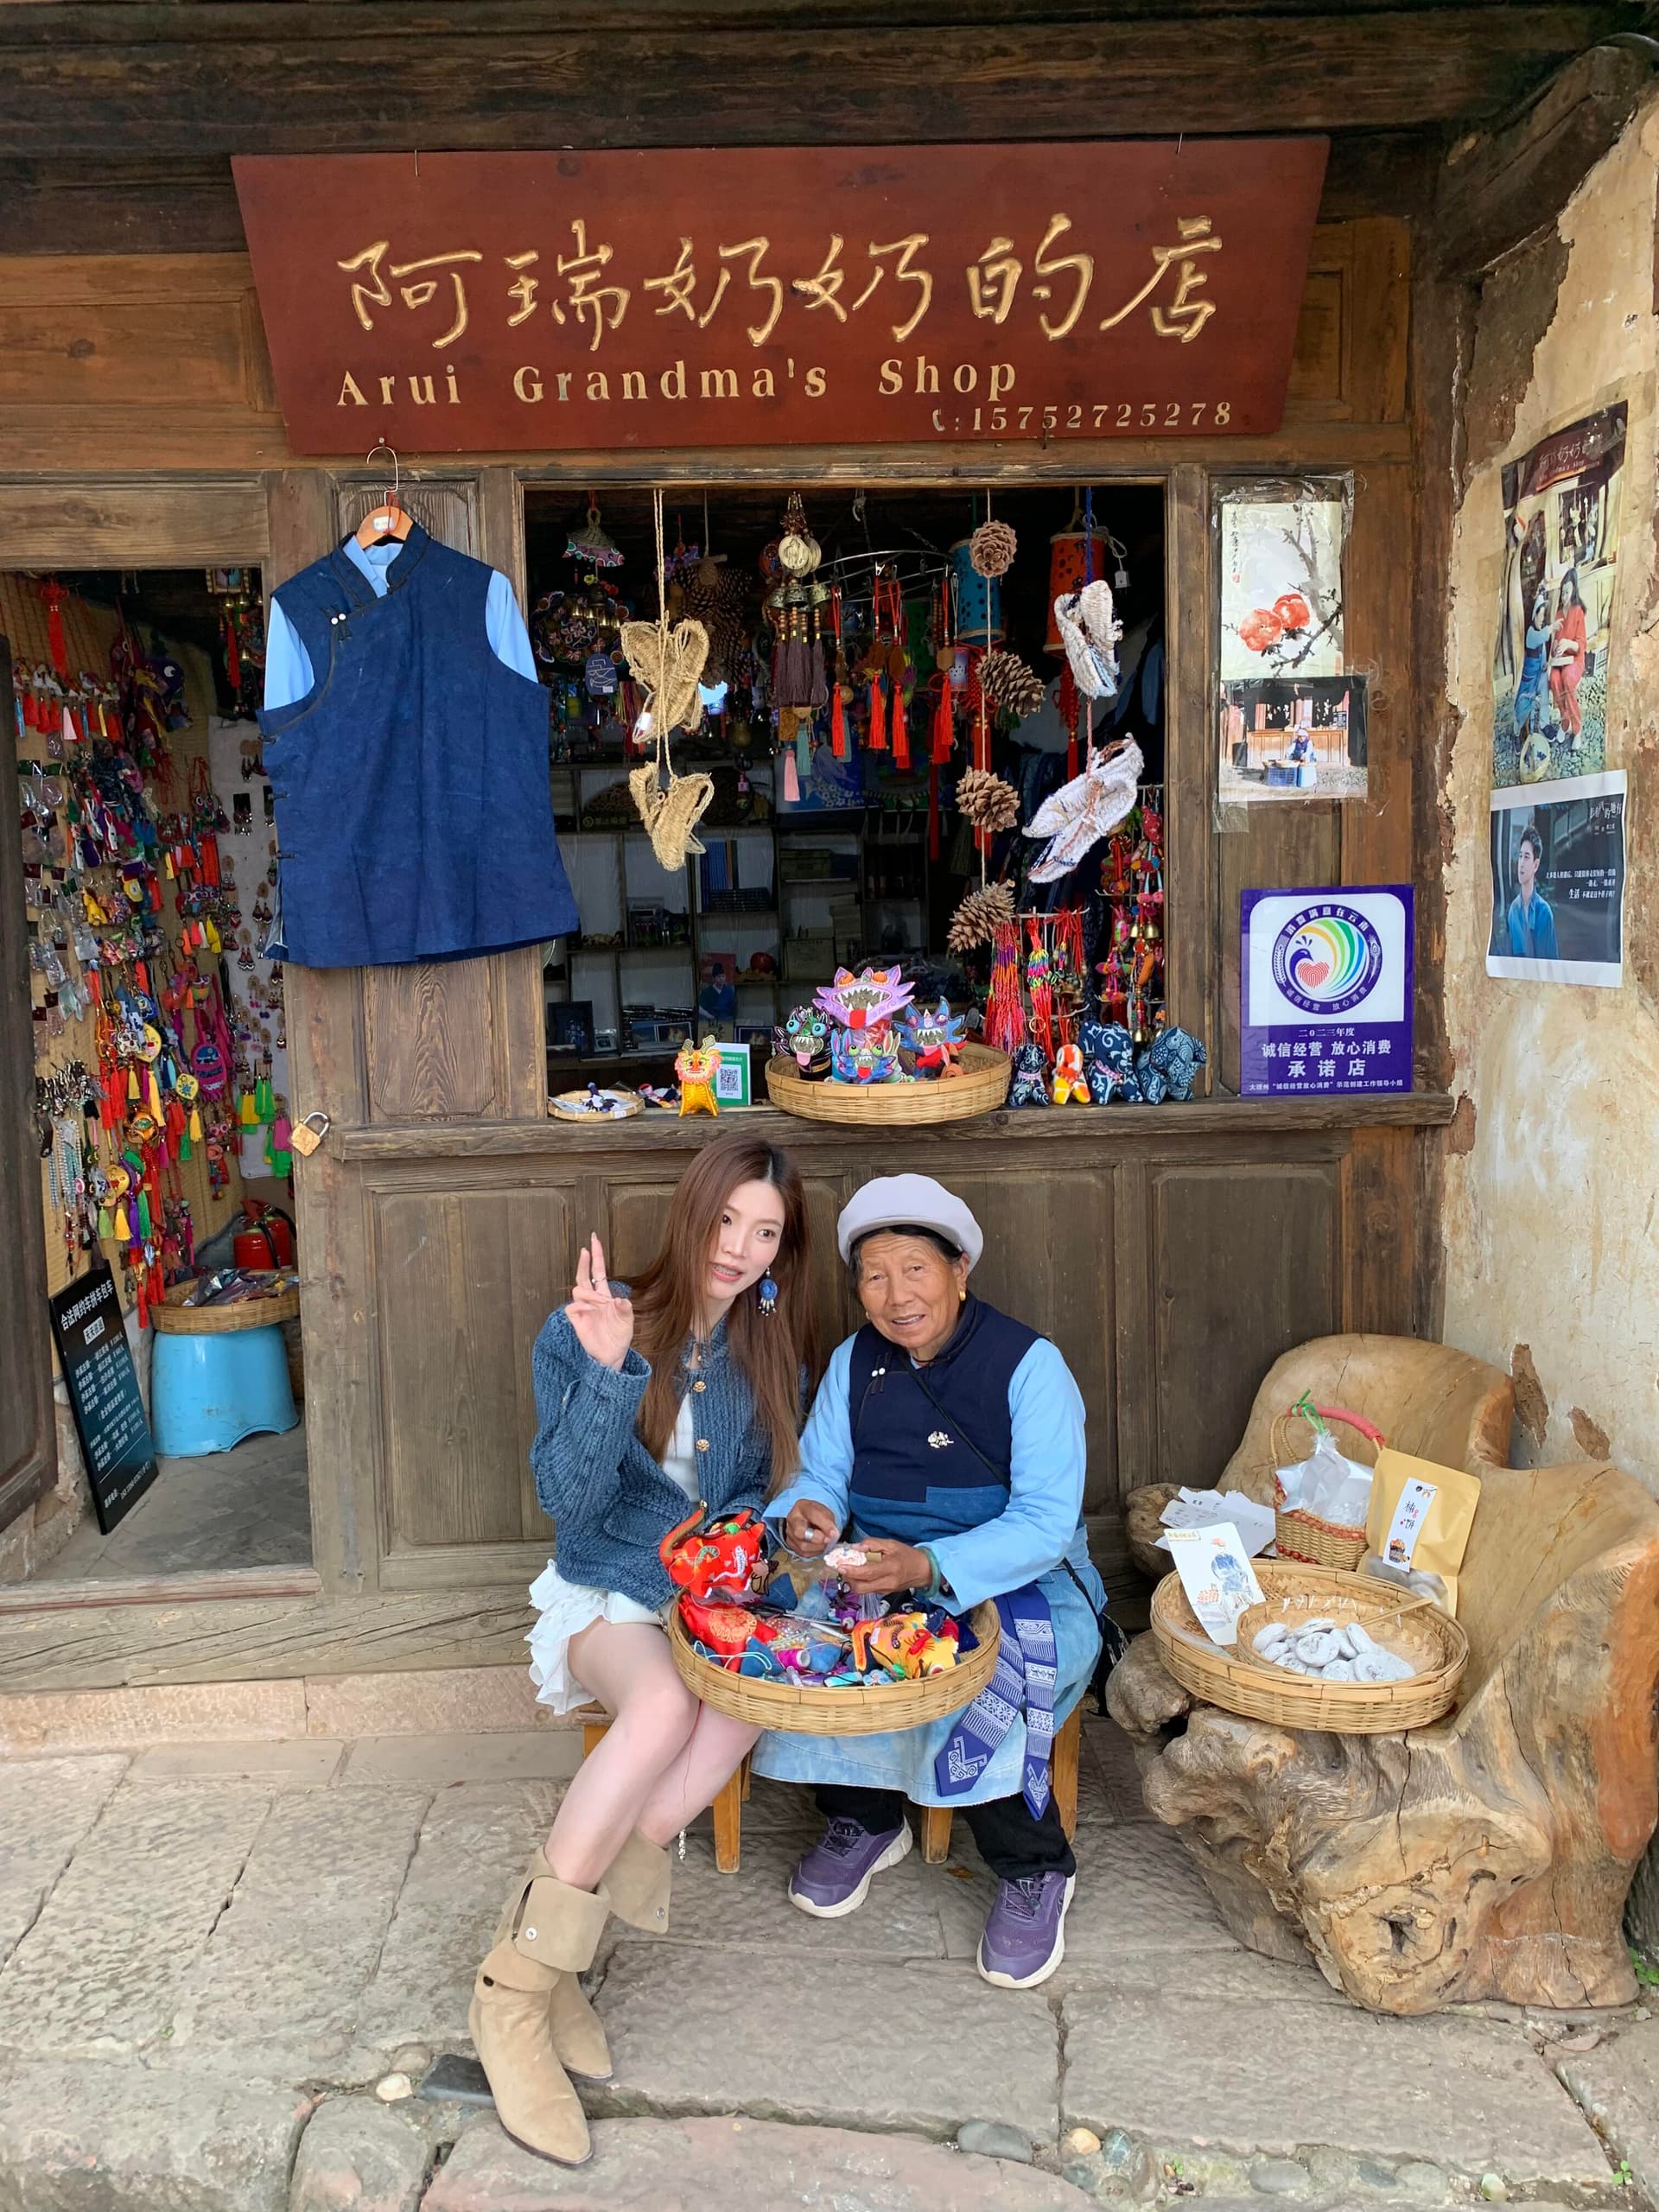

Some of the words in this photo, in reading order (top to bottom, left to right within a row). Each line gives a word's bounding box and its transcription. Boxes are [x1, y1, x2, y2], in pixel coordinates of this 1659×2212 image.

[338, 213, 1223, 351] 阿瑞奶奶的店
[336, 367, 461, 409] Arui
[512, 359, 827, 405] Grandma's
[877, 356, 1017, 402] Shop
[1262, 1040, 1323, 1058] 诚信经营
[1331, 1039, 1391, 1056] 放心消费
